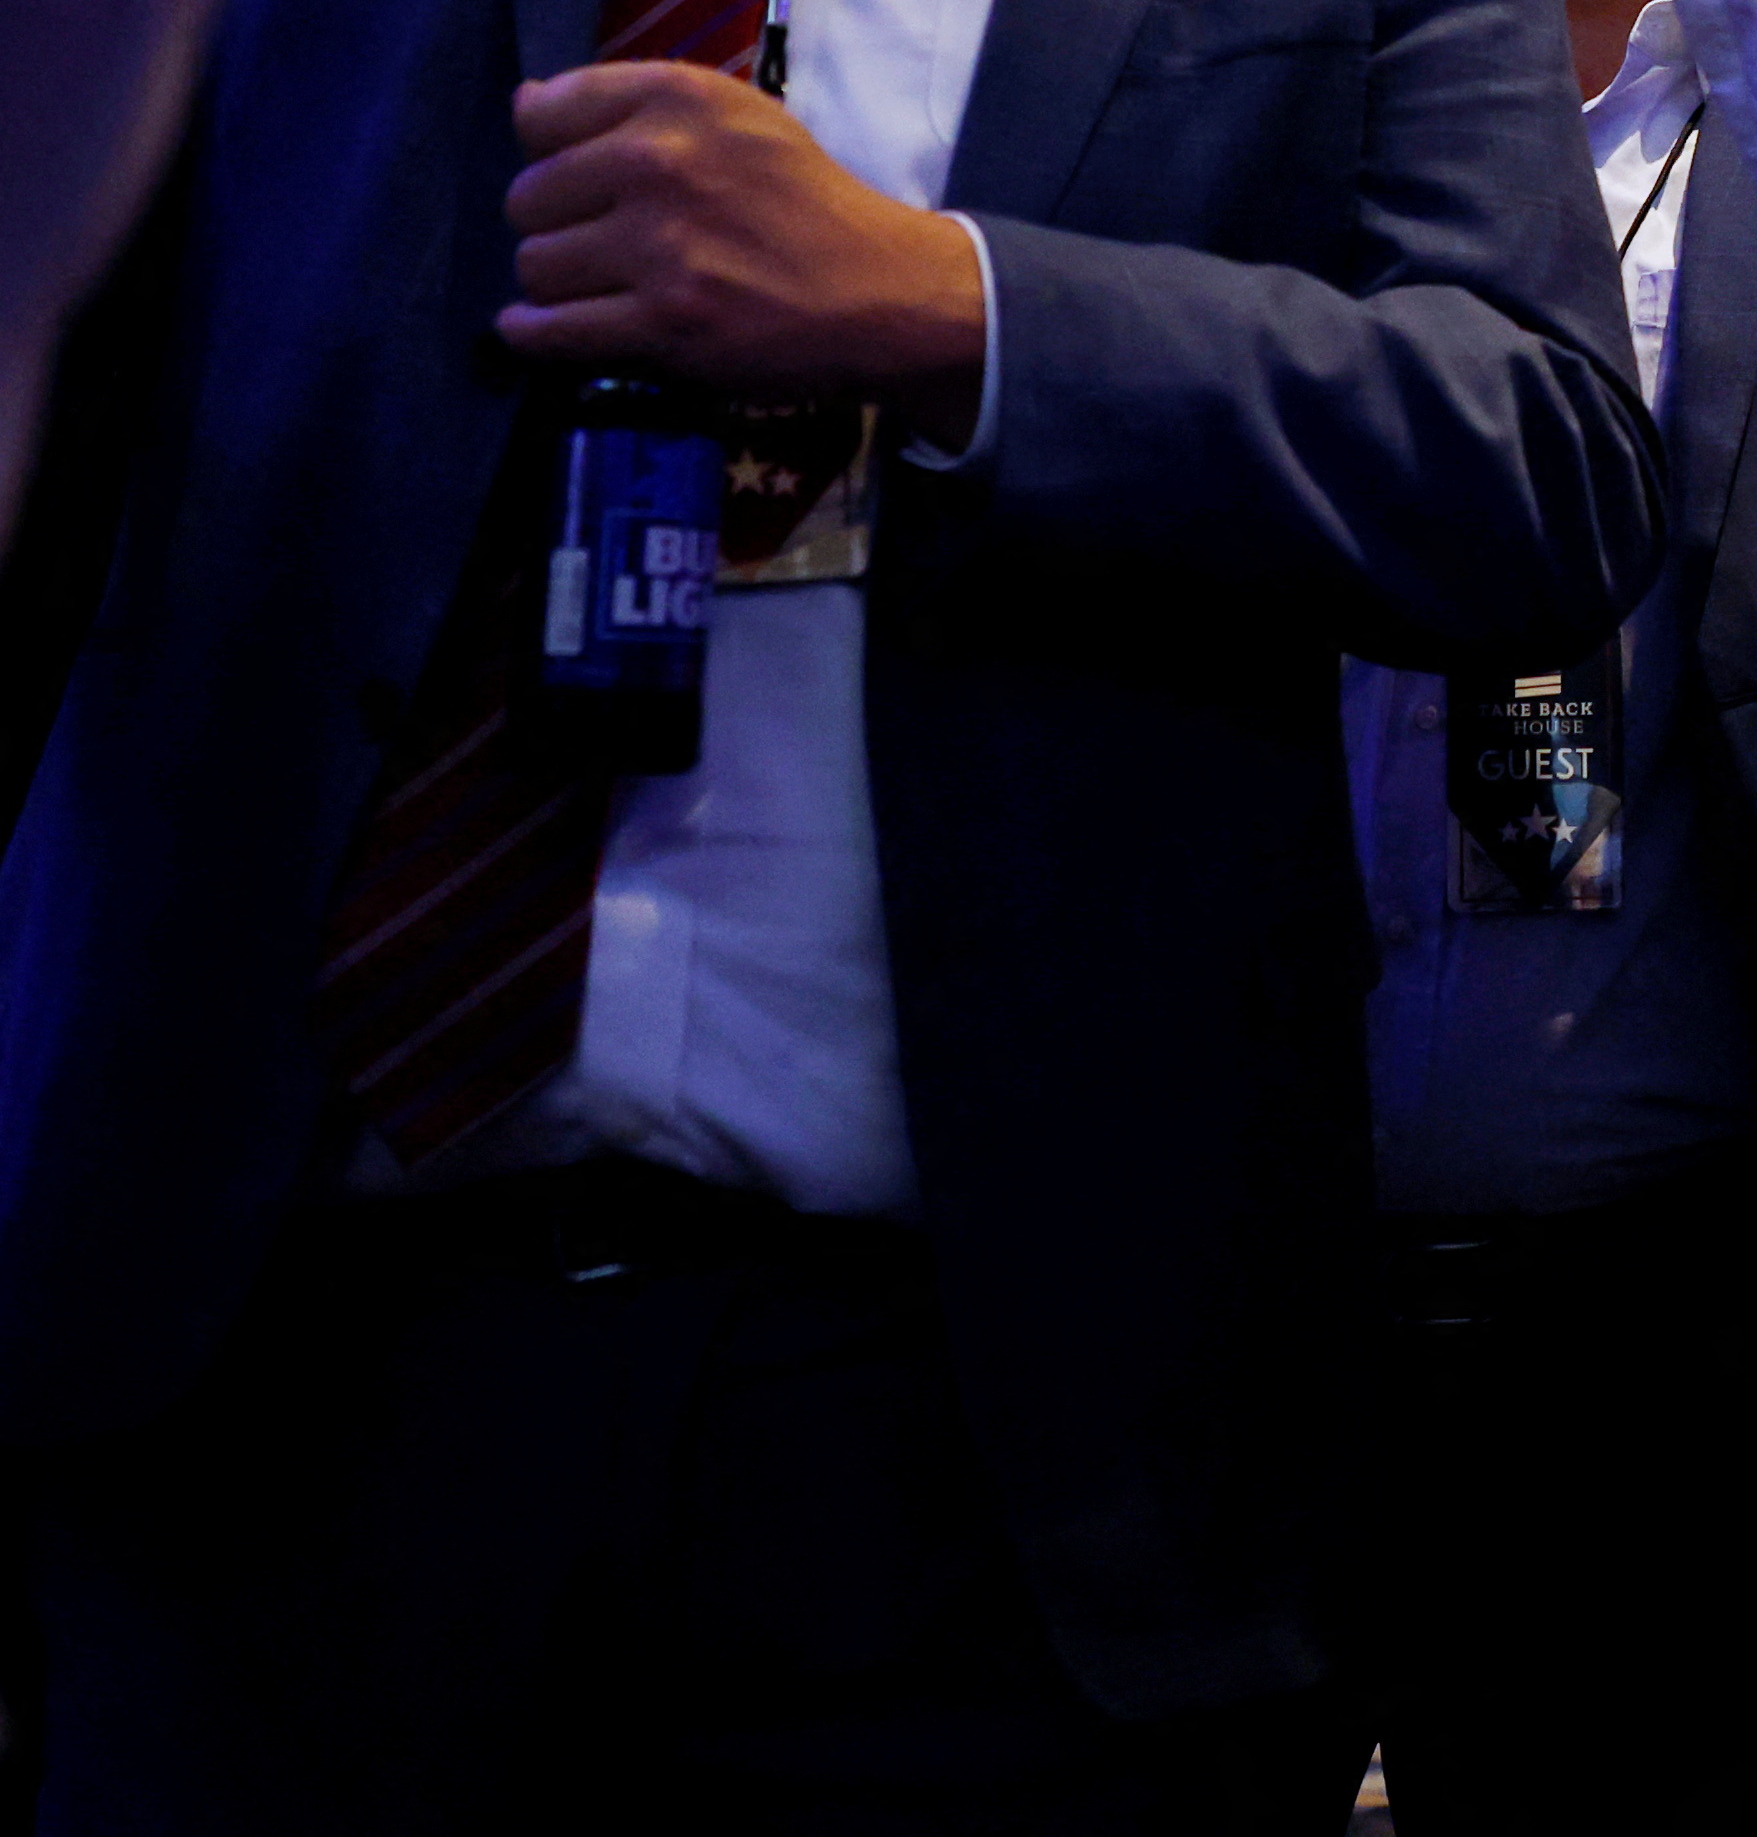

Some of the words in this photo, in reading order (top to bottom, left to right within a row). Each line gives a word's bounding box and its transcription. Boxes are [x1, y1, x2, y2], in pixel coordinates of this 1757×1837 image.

[1478, 702, 1531, 718] TAKE
[1539, 701, 1594, 717] BACK
[1513, 719, 1584, 735] HOUSE
[1477, 746, 1594, 781] GUEST
